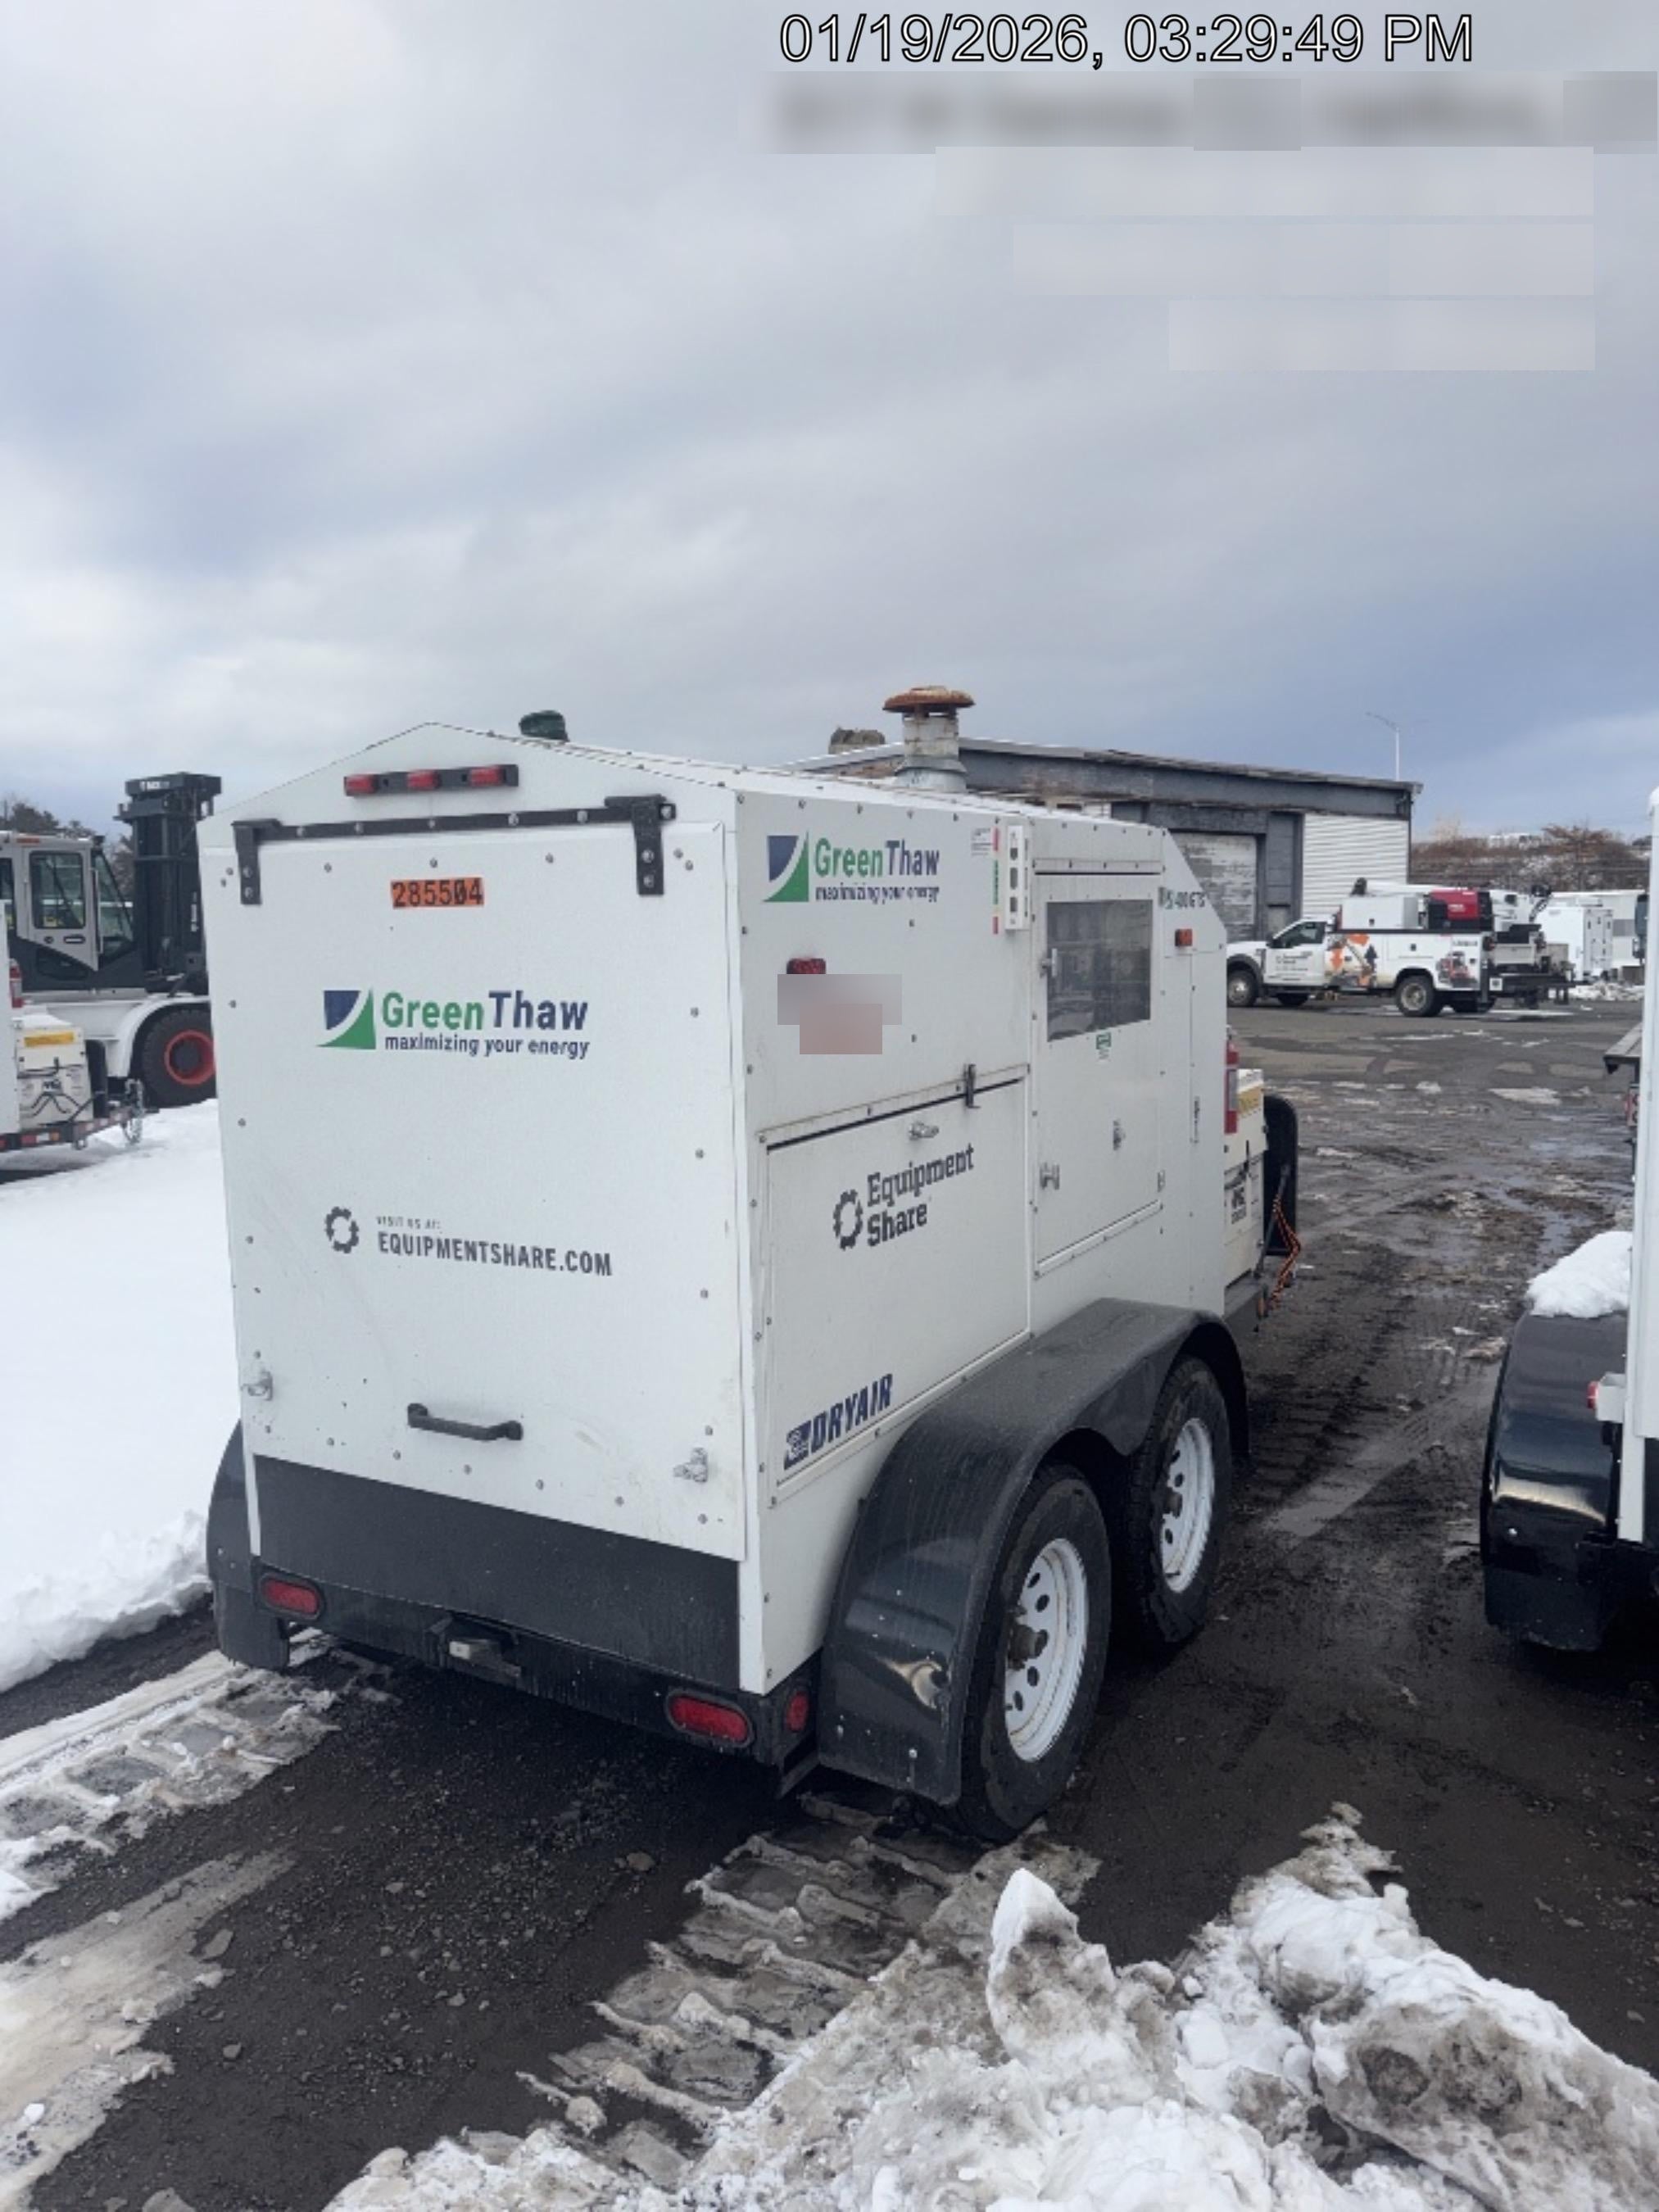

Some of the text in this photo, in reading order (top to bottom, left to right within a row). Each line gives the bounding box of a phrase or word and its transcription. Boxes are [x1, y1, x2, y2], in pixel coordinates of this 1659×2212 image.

[815, 836, 940, 878] GreenThaw
[392, 877, 483, 908] 285504
[382, 990, 588, 1031] GreenThaw
[384, 1032, 591, 1060] maximizing your energy
[867, 1142, 974, 1208] Equipment
[867, 1203, 927, 1247] Share
[377, 1231, 613, 1276] EQUIPMENTSHARE.COM
[810, 1373, 893, 1454] DRYAIR
